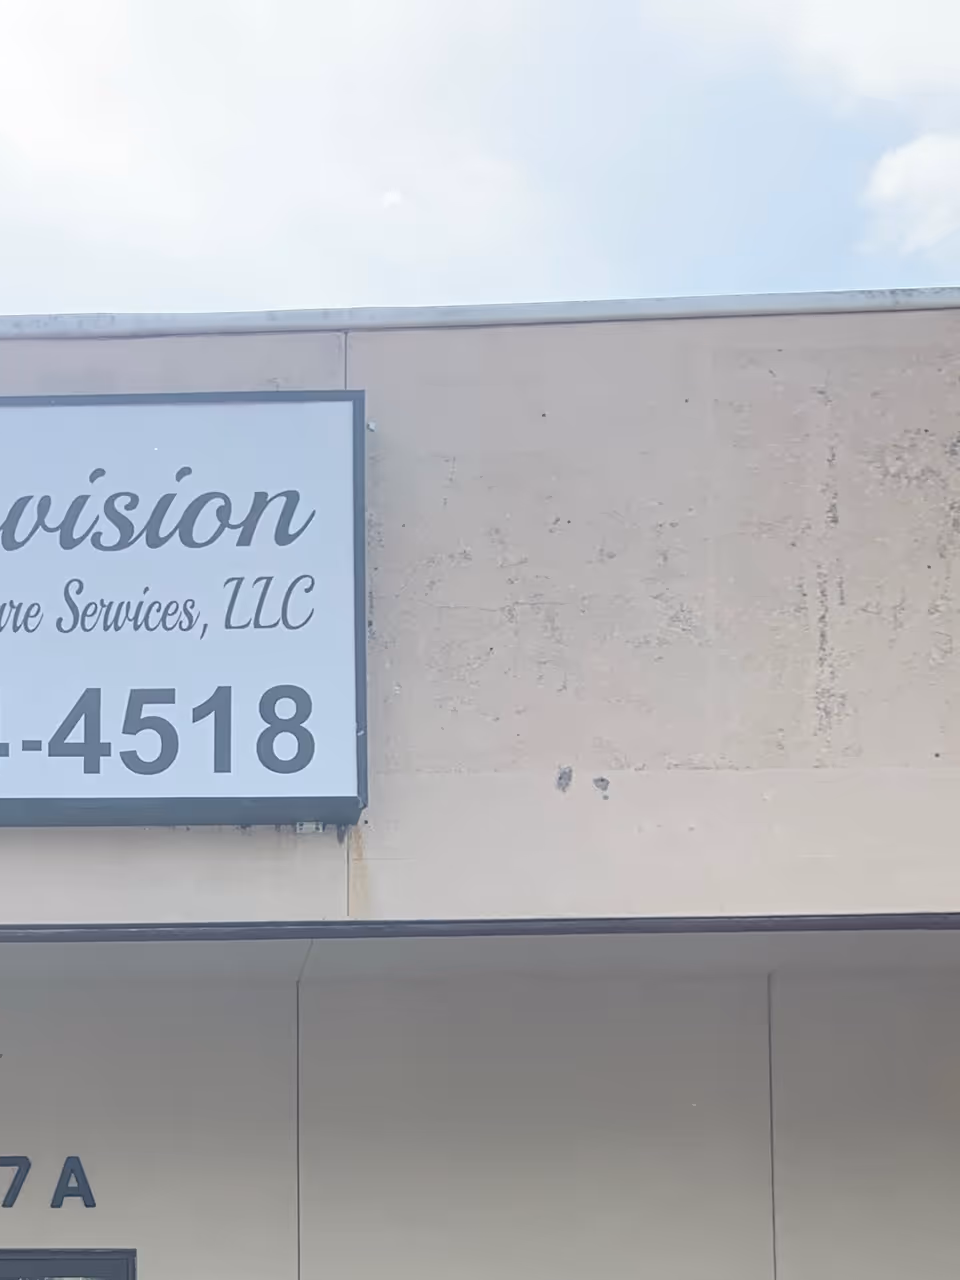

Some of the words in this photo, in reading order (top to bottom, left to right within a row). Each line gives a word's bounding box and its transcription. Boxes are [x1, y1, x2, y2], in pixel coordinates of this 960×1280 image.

[55, 582, 210, 640] Services,
[223, 573, 315, 631] LLC
[50, 1156, 96, 1208] A
